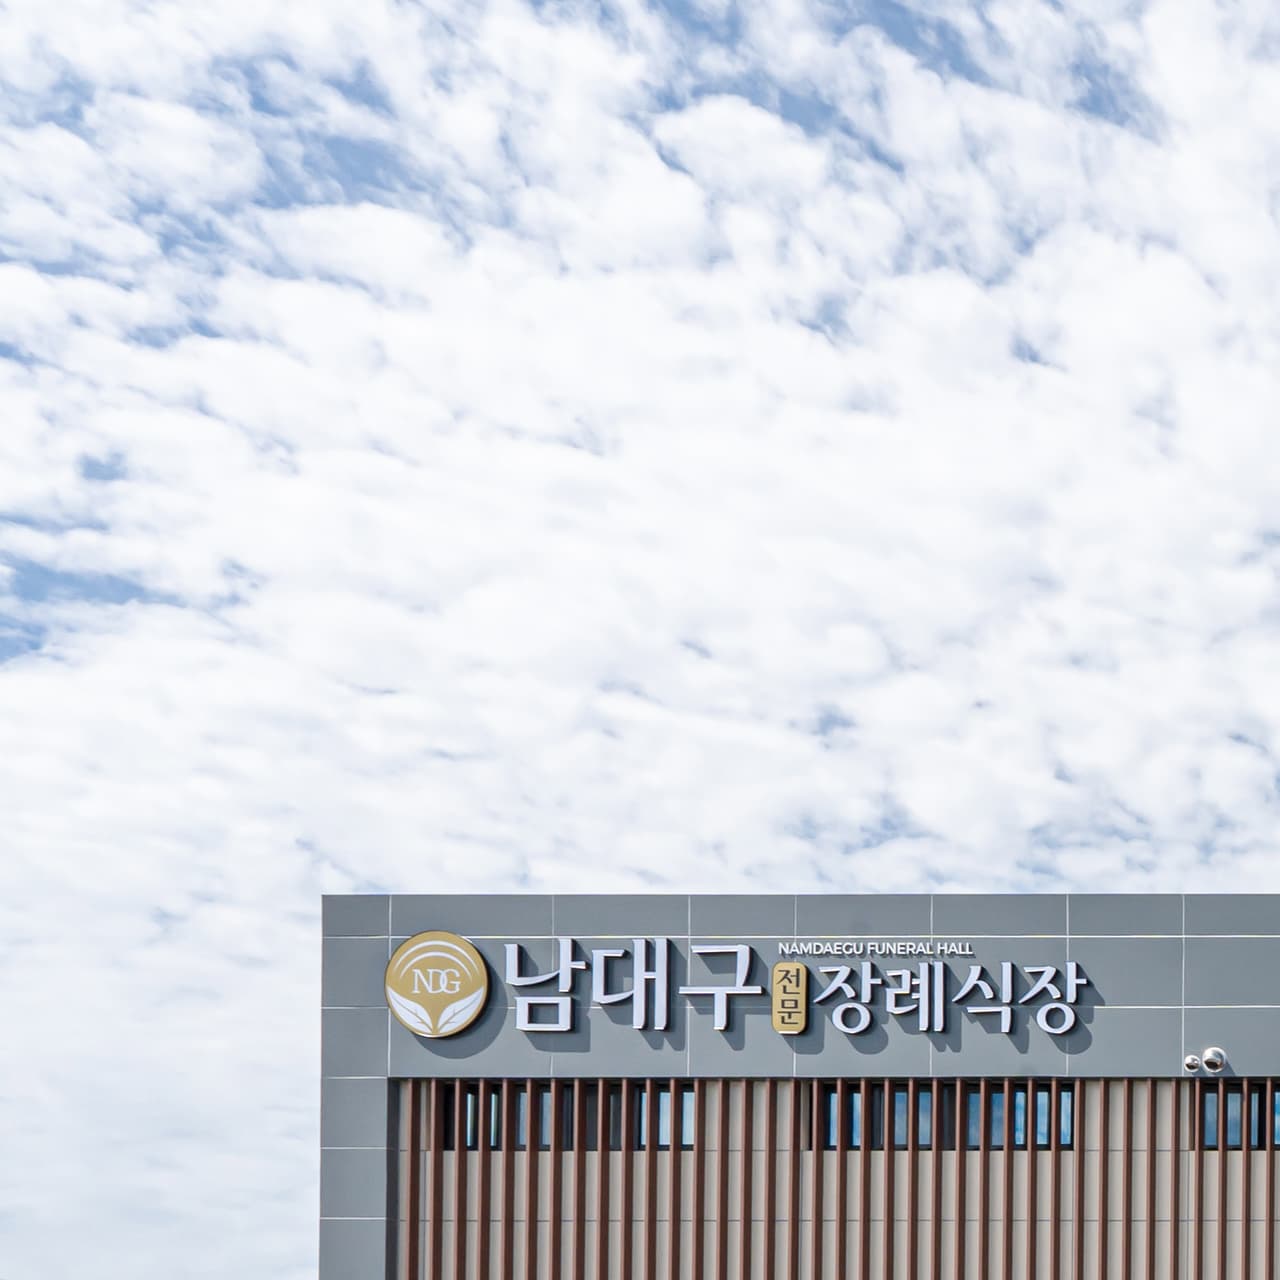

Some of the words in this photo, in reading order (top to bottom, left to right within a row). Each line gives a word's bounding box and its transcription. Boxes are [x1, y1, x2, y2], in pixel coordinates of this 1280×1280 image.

[778, 941, 863, 956] NAMDAEGU
[867, 942, 934, 956] FUNERAL
[937, 942, 974, 956] HALL
[412, 968, 461, 995] NDG
[504, 937, 763, 1032] 남대구
[775, 967, 802, 1026] 전문
[812, 960, 1088, 1035] 장례식장
